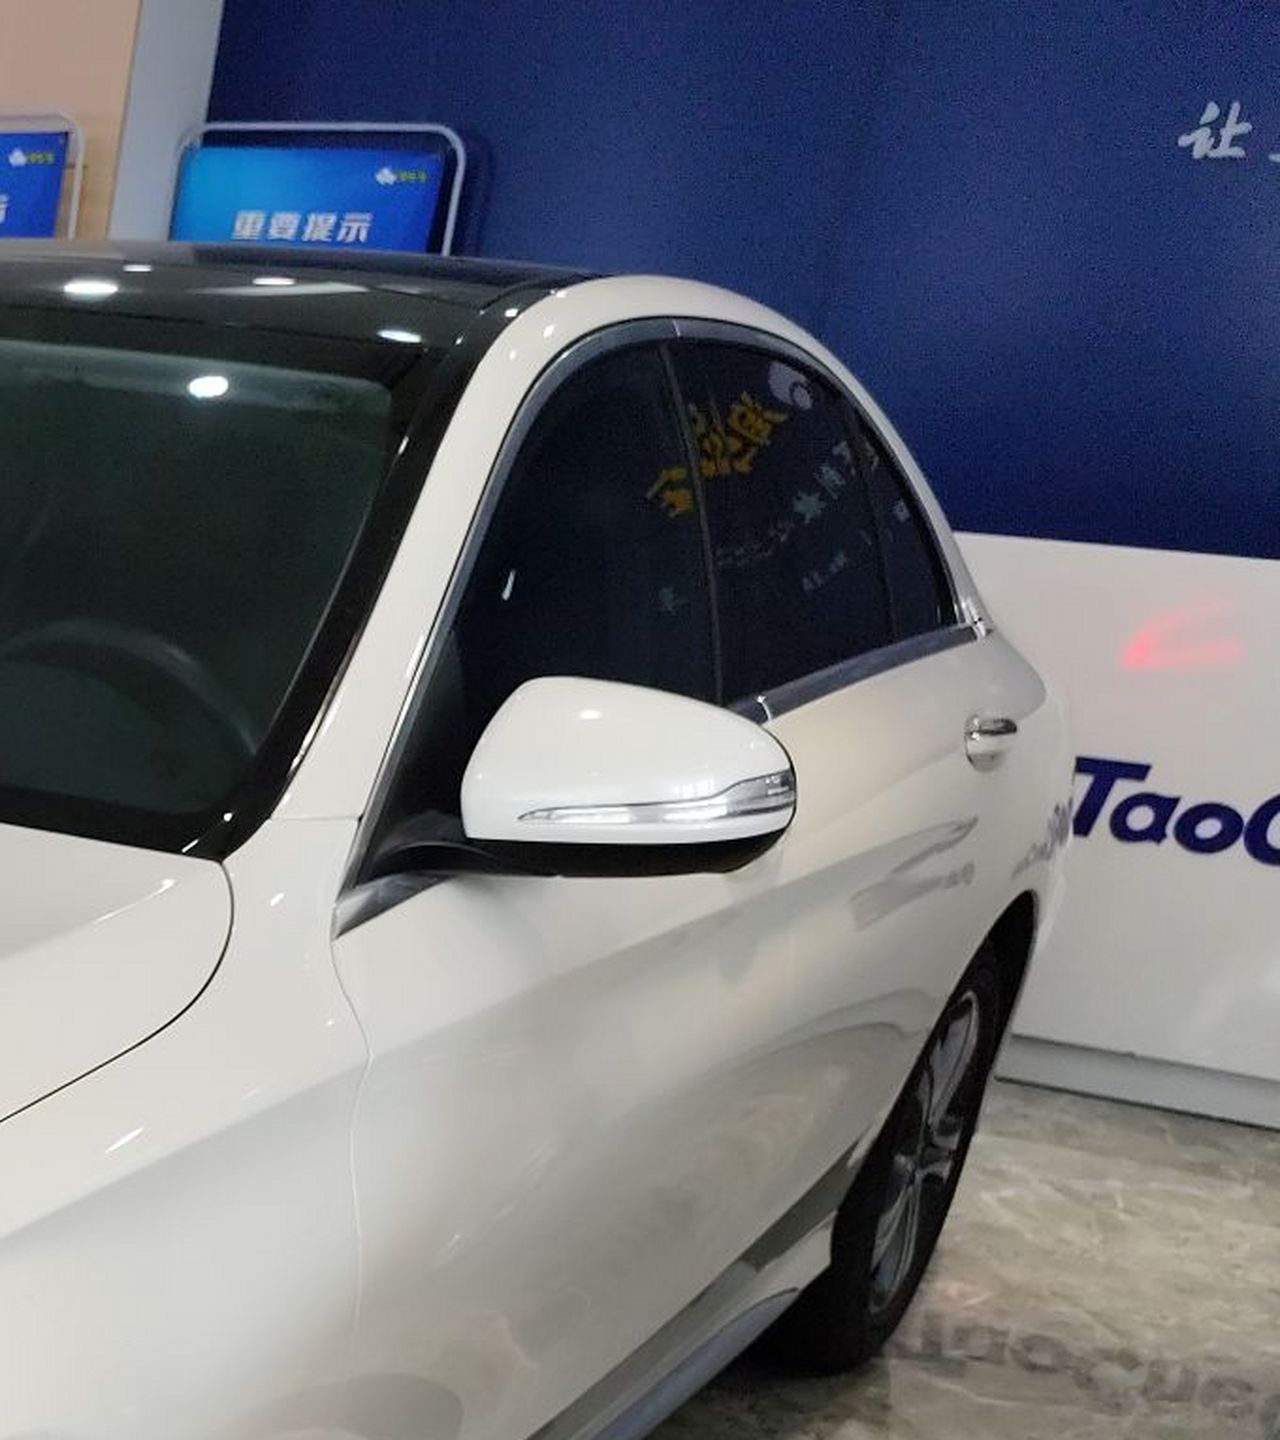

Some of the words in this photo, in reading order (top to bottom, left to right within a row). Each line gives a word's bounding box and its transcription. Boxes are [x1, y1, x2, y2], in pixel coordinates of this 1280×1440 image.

[1177, 101, 1280, 163] 让
[232, 211, 373, 243] 重要提示
